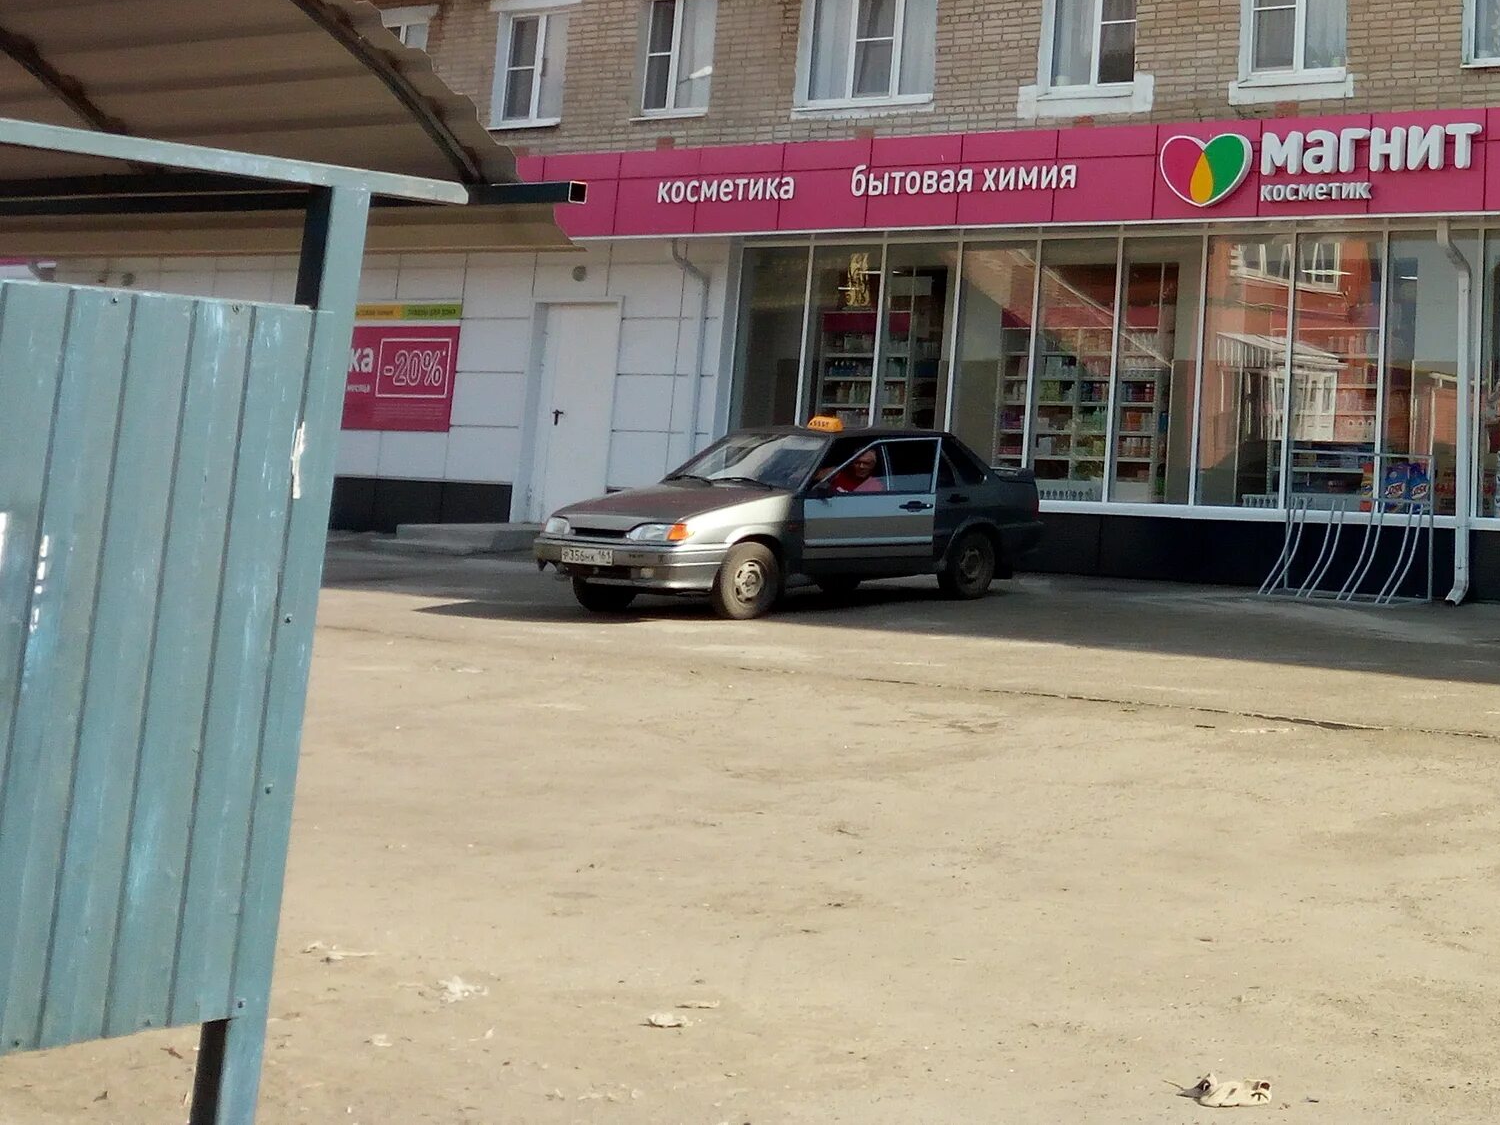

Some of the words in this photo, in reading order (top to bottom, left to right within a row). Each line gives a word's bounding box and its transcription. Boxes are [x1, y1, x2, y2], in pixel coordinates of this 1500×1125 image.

[656, 174, 796, 204] косметика
[850, 163, 974, 197] бытовая
[981, 163, 1078, 194] химия
[1260, 180, 1374, 203] косметик
